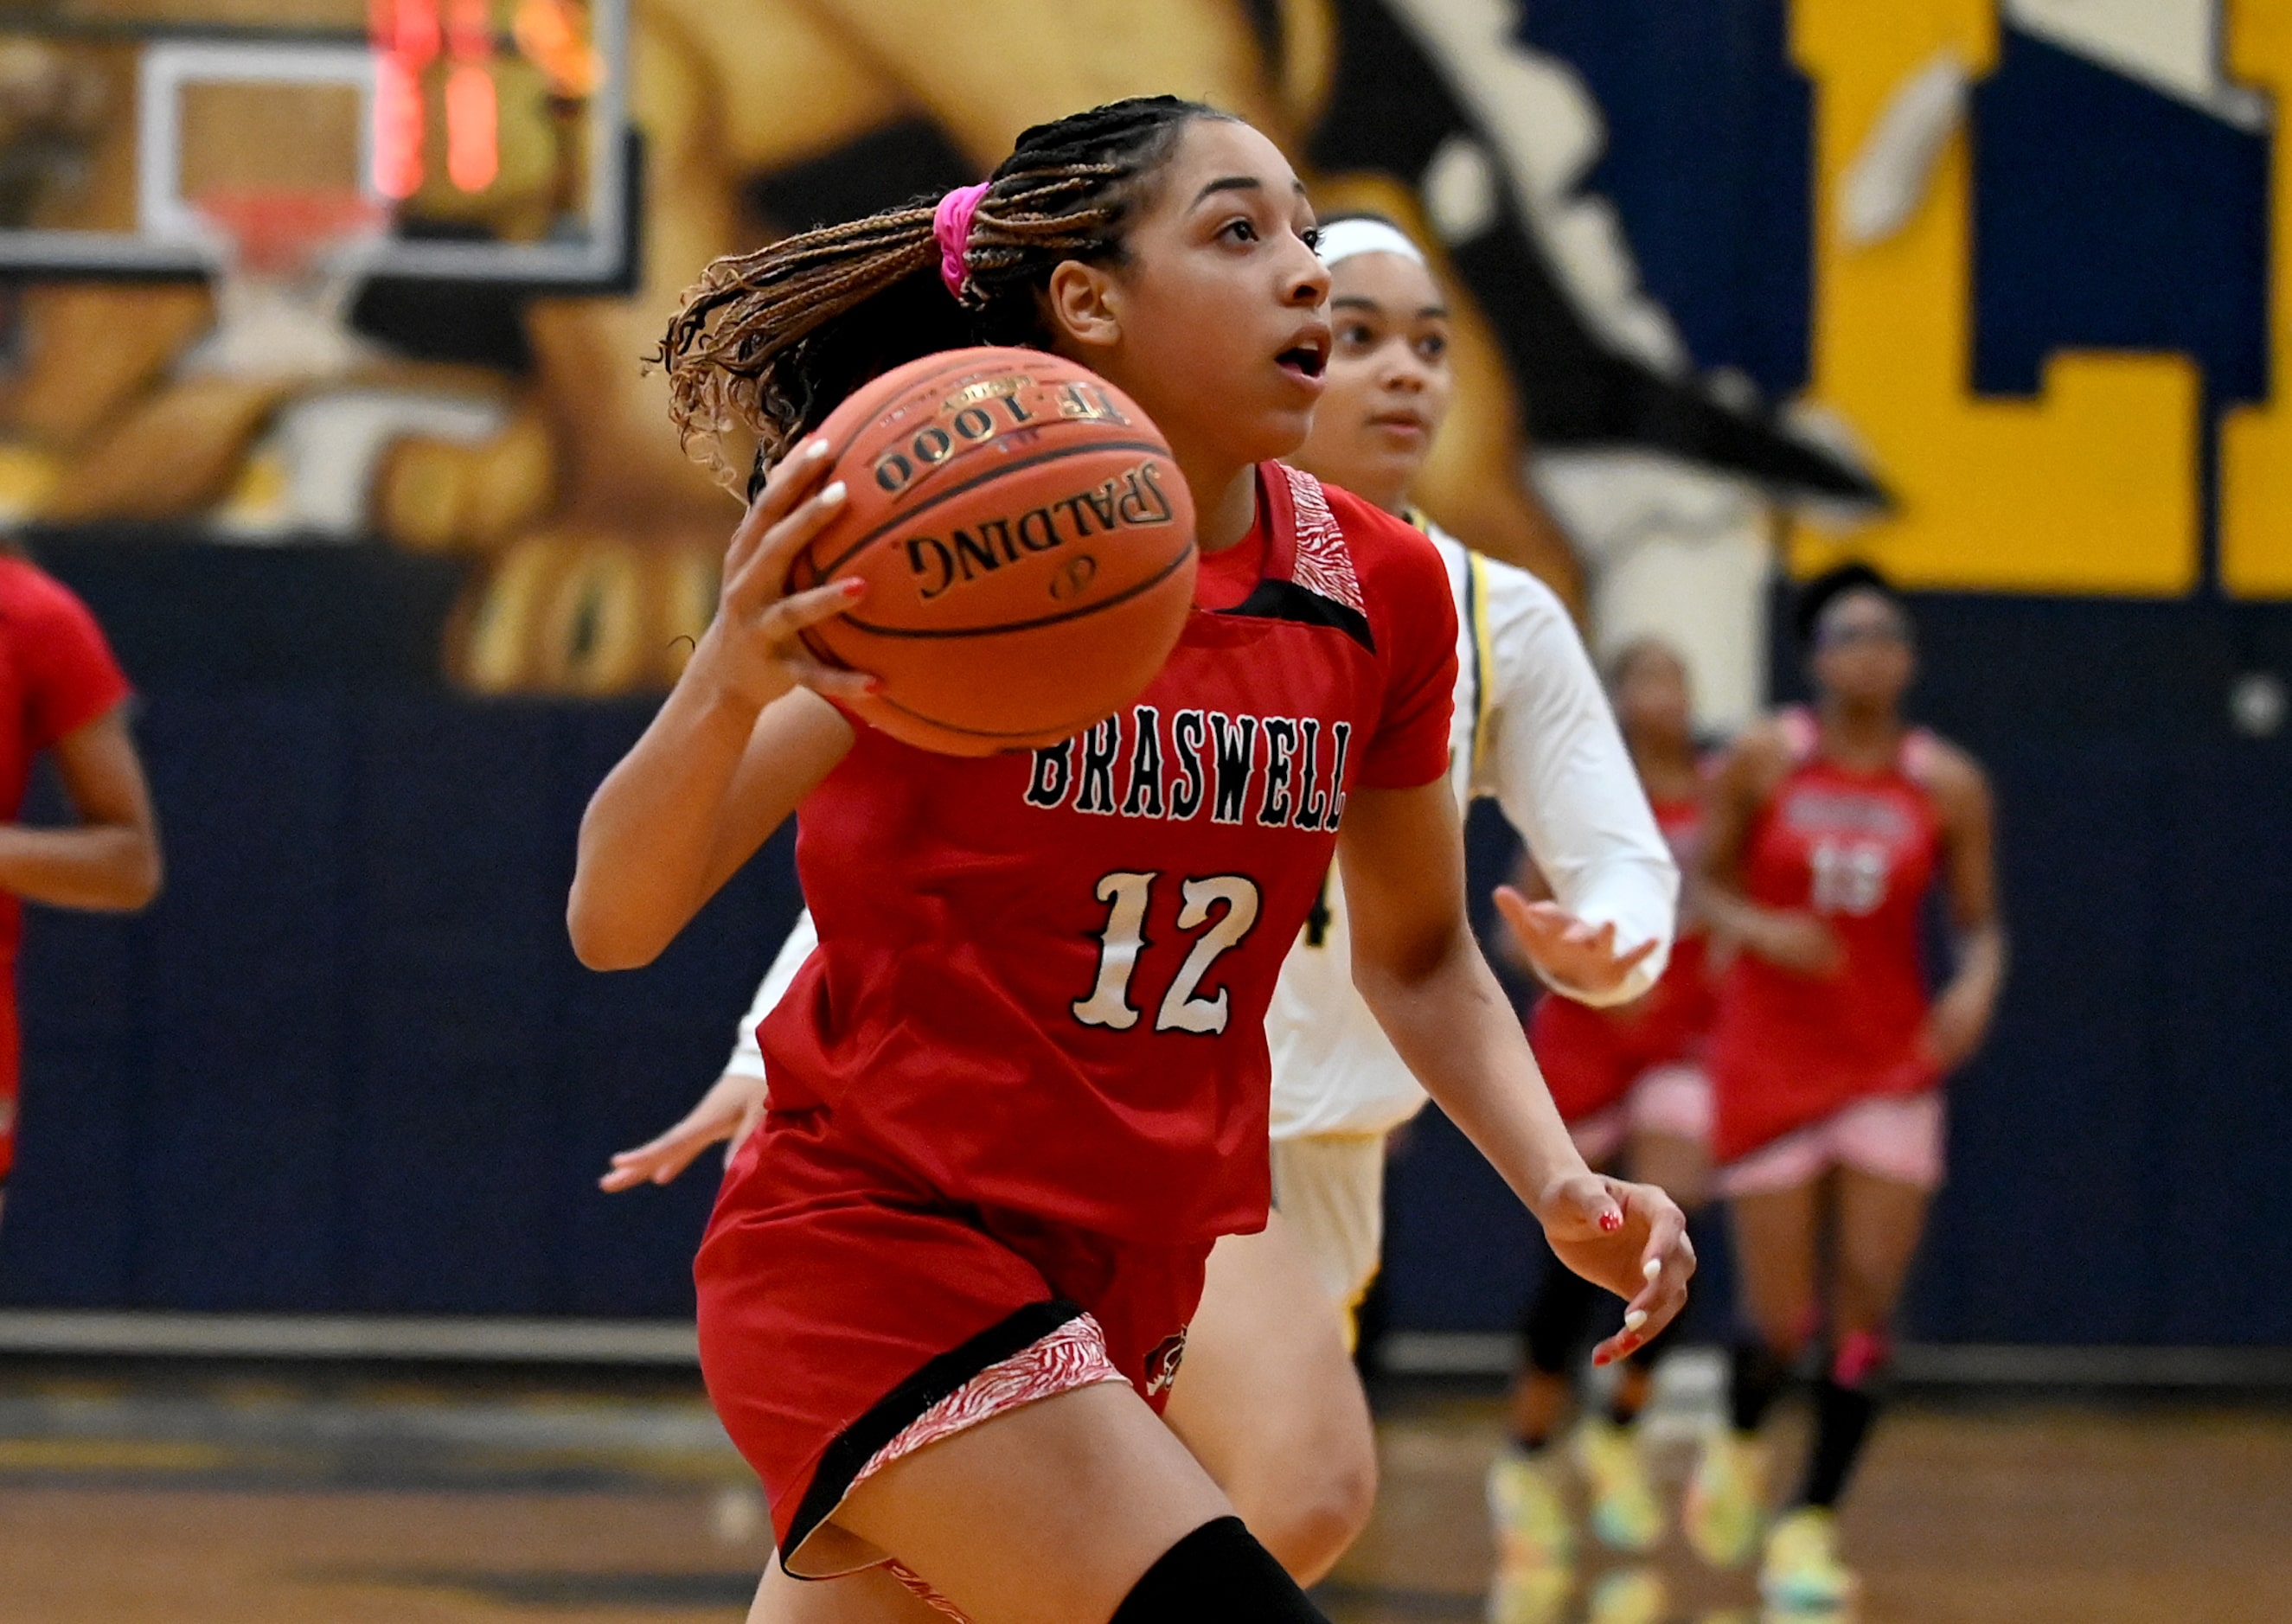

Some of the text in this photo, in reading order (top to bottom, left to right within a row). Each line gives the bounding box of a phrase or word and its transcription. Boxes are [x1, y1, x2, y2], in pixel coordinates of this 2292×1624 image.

[905, 460, 1173, 600] SPALDING
[1023, 705, 1351, 833] BRASWELL
[1070, 871, 1261, 1036] 12
